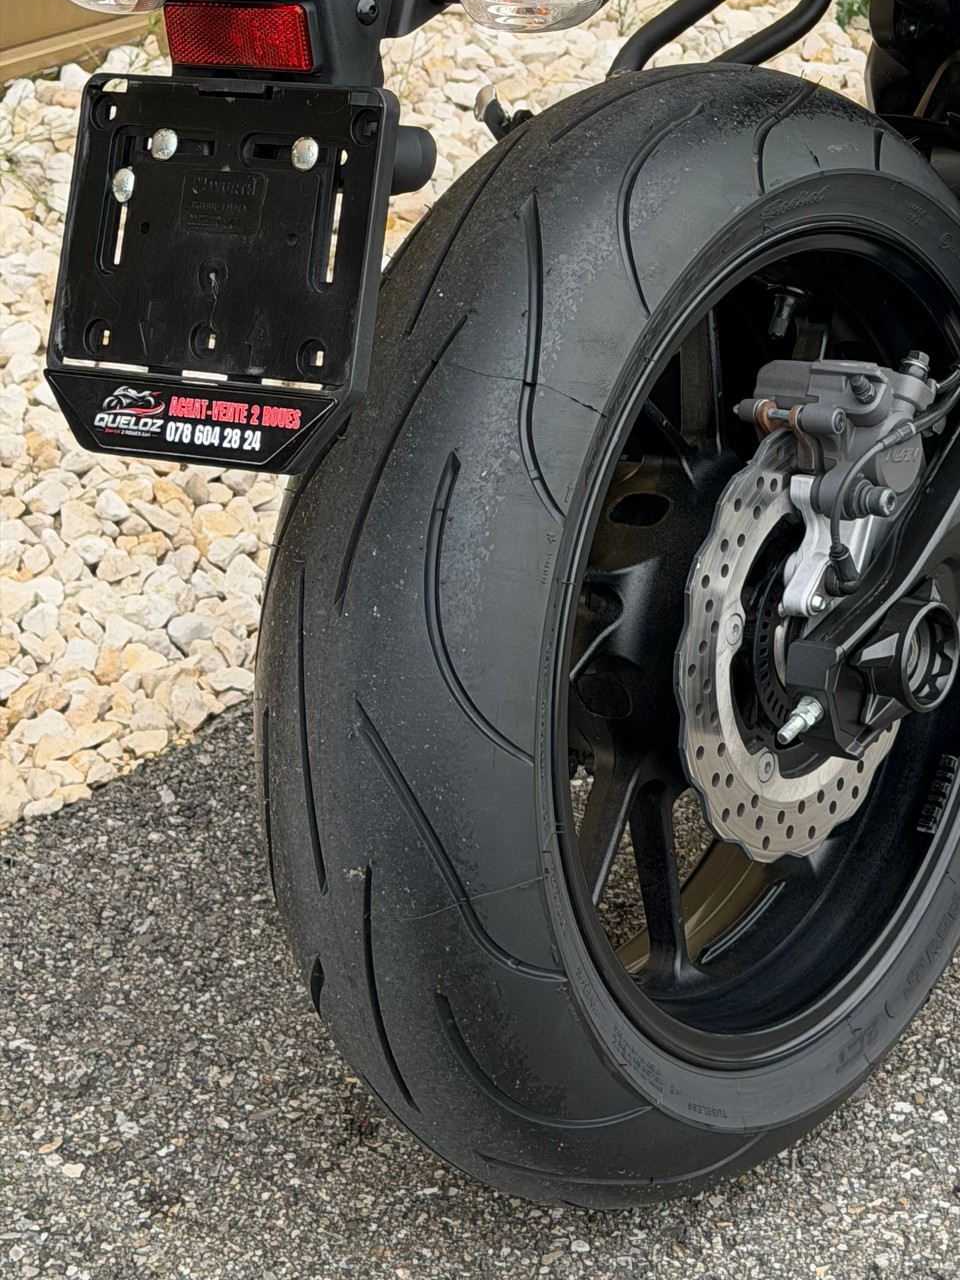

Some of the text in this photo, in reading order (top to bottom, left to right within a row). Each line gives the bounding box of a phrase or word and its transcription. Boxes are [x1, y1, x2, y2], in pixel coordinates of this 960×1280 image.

[93, 413, 165, 433] QUELOZ
[168, 396, 302, 429] ACHAT-VENTE 2 ROUES
[165, 421, 262, 452] 078 604 28 24
